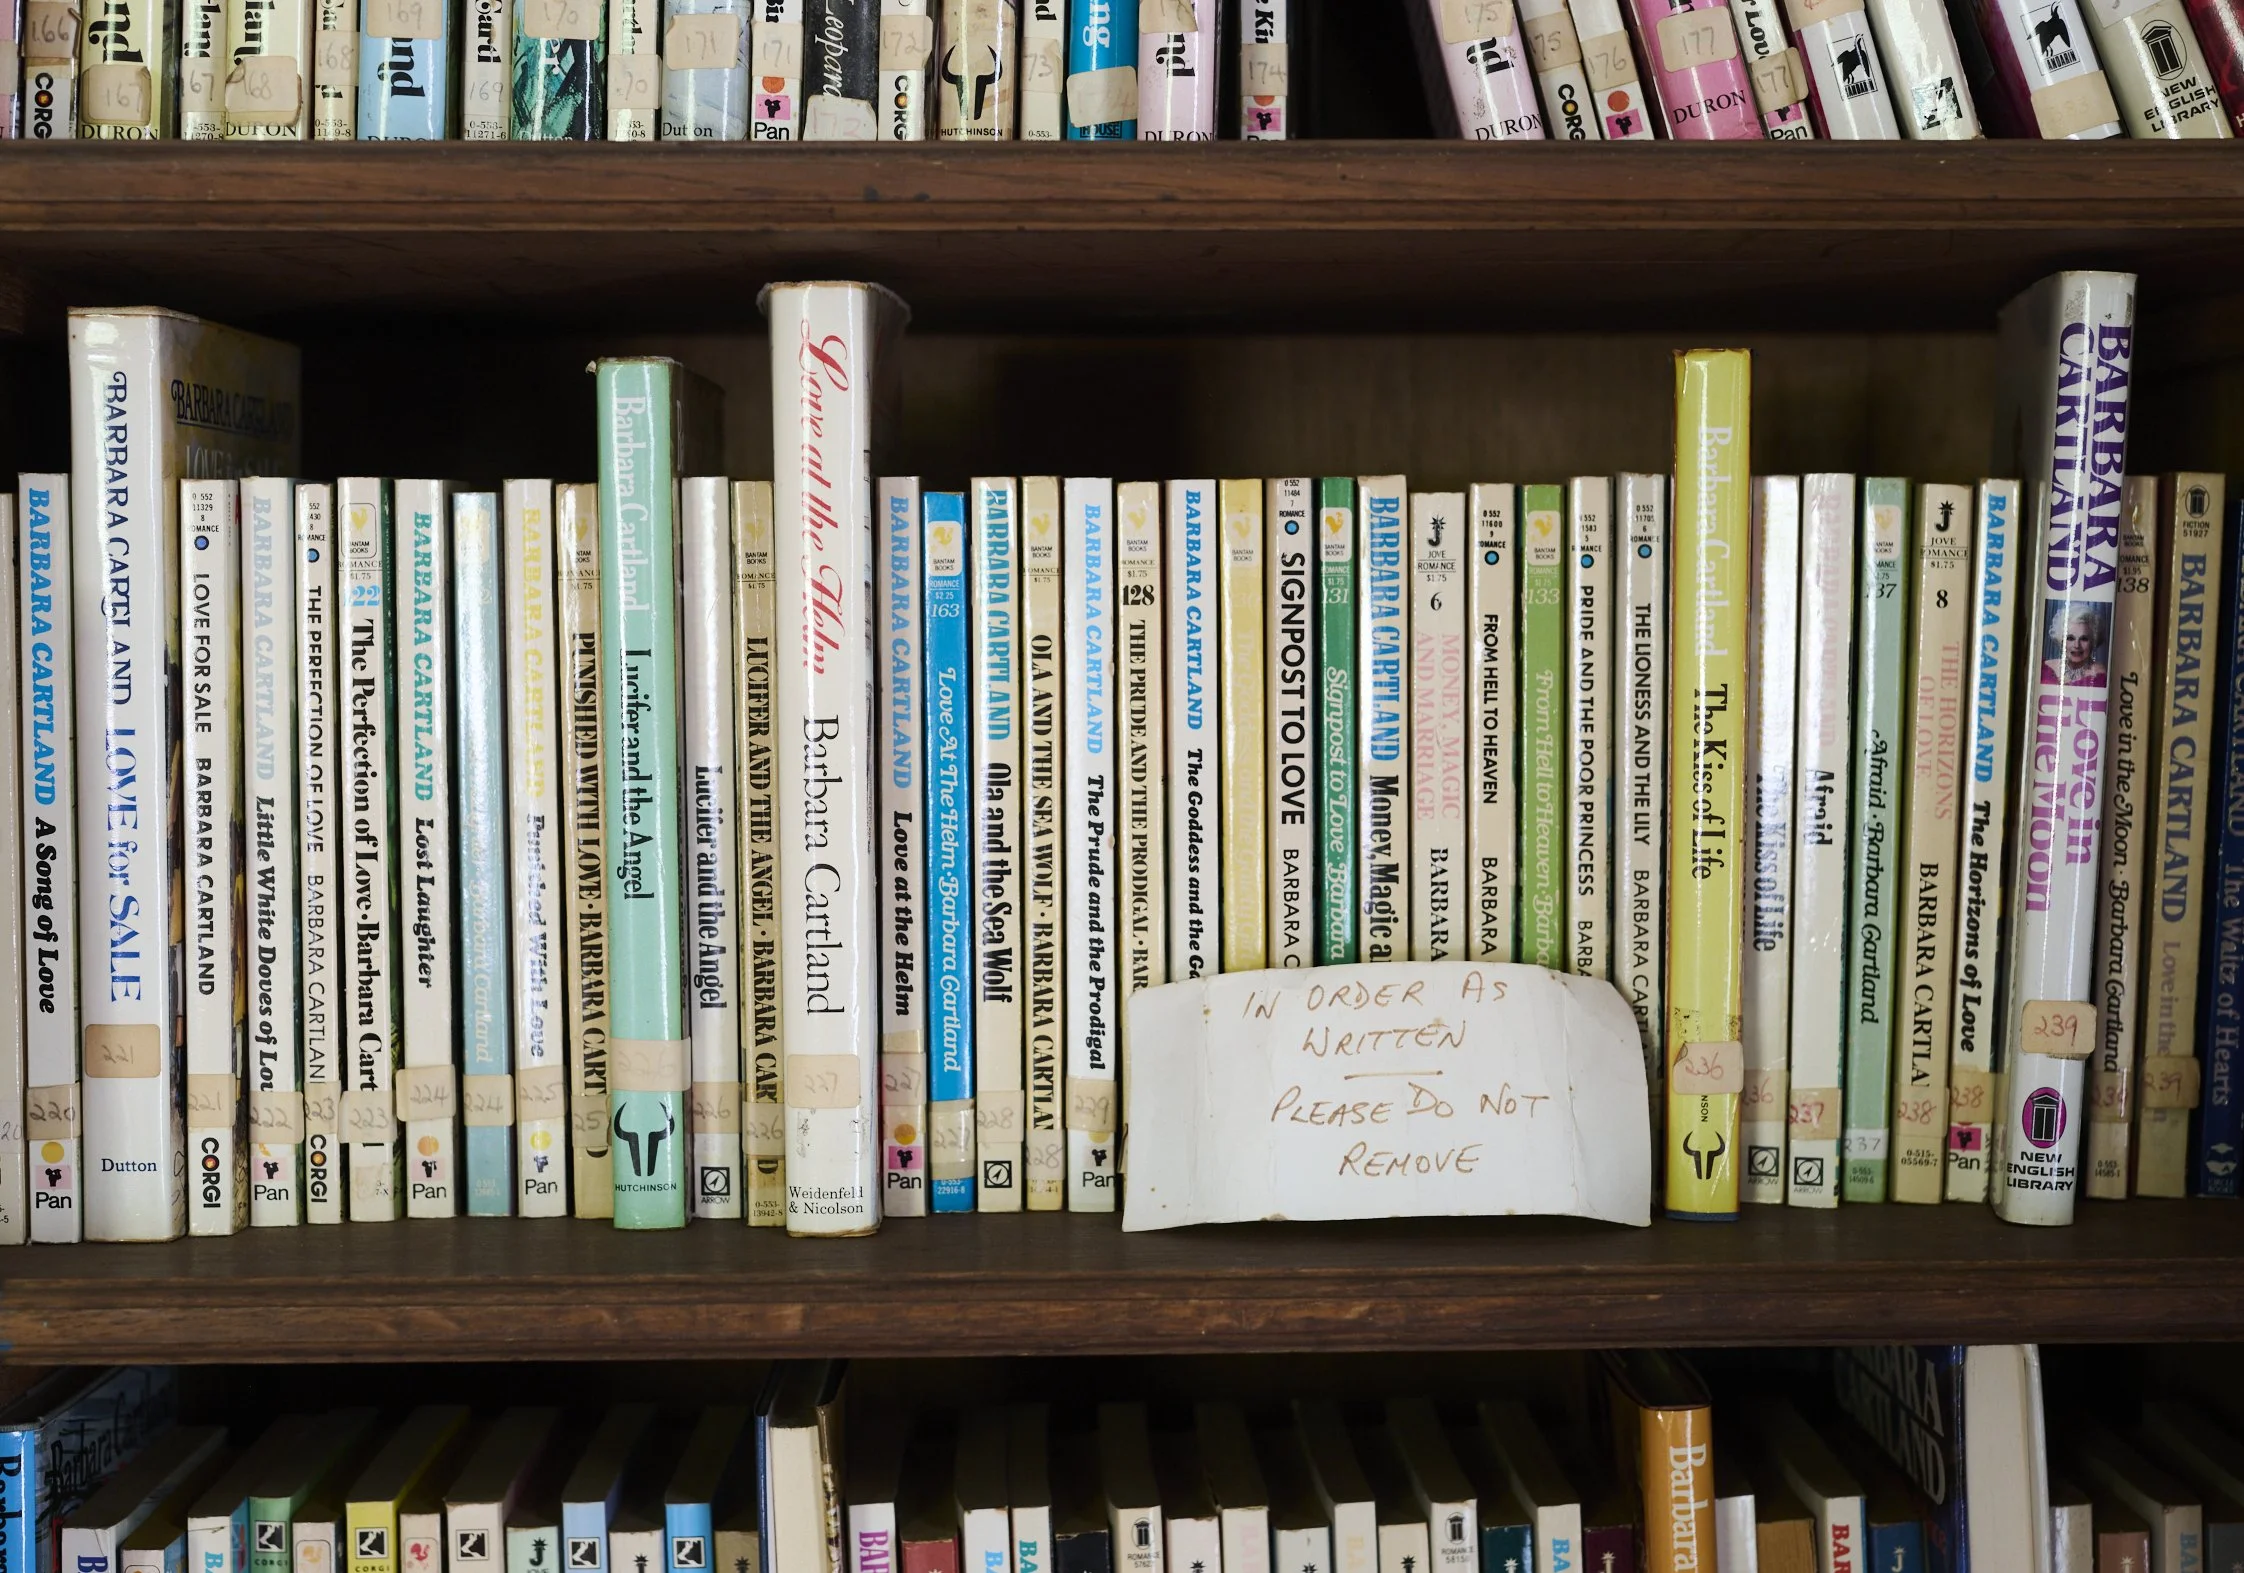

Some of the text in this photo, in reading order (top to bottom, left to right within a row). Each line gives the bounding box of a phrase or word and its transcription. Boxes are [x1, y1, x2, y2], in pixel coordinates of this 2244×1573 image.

[33, 73, 54, 139] CORG
[1672, 88, 1746, 125] DURON
[226, 122, 297, 138] DURON
[754, 122, 790, 140] Pan
[940, 127, 1003, 138] HUTCHINSON
[1476, 112, 1541, 141] DURON
[2046, 322, 2095, 592] CARTLAND
[2083, 323, 2133, 593] BARBARA
[614, 396, 650, 610] Barbara Cartland
[1279, 510, 1305, 518] ROMANCE
[1694, 425, 1732, 656] Barbara Cartland
[1931, 538, 1957, 546] JOVE
[2182, 521, 2211, 530] FICTION
[931, 604, 961, 618] 163
[1122, 584, 1155, 606] 128
[1431, 592, 1442, 611] 6
[1936, 589, 1949, 609] 8
[1185, 490, 1205, 951] BARBARA CARTLAND The Goddess and the
[1364, 496, 1400, 938] BARBARA CARTLAND Money, Magic
[29, 488, 60, 1014] BARBARA CARTLAND A Song of Love
[412, 512, 436, 988] BARBARA CARTLAND Lost Laughter
[891, 495, 914, 1016] BARBARA CARTLAND Love at the Helm
[1281, 552, 1306, 948] SIGNPOST TO LOVE BARBARA
[193, 573, 215, 996] LOVE FOR SALE BARBARA CARTLAND
[617, 648, 654, 901] Lucifer and the Angel
[1085, 503, 1106, 1070] BARBARA CARTLAND The Prude and the Prodigal
[1481, 613, 1499, 956] FROM HELL TO HEAVEN BARBARA
[1960, 493, 2007, 1053] BARBARA CARTLAND The Horizons of Love
[2066, 697, 2108, 866] Love in
[1804, 768, 1835, 846] Afraid
[2025, 693, 2073, 912] the Moon
[746, 637, 778, 1047] LUCIFER AND THE ANGEL BARBARA
[693, 765, 728, 1009] Lucifer and the Angel
[1430, 849, 1449, 962] BARBARA
[1242, 970, 1507, 1021] IN ORDER AS
[1301, 1020, 1468, 1058] WRITTEN
[2033, 1014, 2078, 1047] 239
[1685, 1052, 1723, 1080] 236
[29, 1101, 76, 1122] 220
[1270, 1086, 1392, 1127] PLEASE
[1479, 1082, 1550, 1119] NOT
[1789, 1103, 1825, 1128] 237
[1897, 1099, 1937, 1125] 238
[101, 1158, 158, 1173] Dutton
[201, 1136, 221, 1209] CORGI
[310, 1134, 328, 1203] CORGI
[1337, 1141, 1484, 1178] REMOVE
[1948, 1153, 1980, 1171] Pan
[2007, 1162, 2075, 1177] ENGLISH
[2021, 1151, 2062, 1163] NEW
[254, 1184, 289, 1201] Pan
[412, 1183, 447, 1199] Pan
[525, 1179, 558, 1195] Pan
[615, 1183, 677, 1193] HUTCHINSON
[789, 1185, 864, 1200] Weidenfeld
[888, 1172, 922, 1189] Pan
[1083, 1171, 1116, 1187] Pan
[2006, 1177, 2074, 1191] LIBRARY
[35, 1192, 72, 1209] Pan
[789, 1202, 864, 1215] & Nicolson
[1668, 1443, 1708, 1573] Barbara
